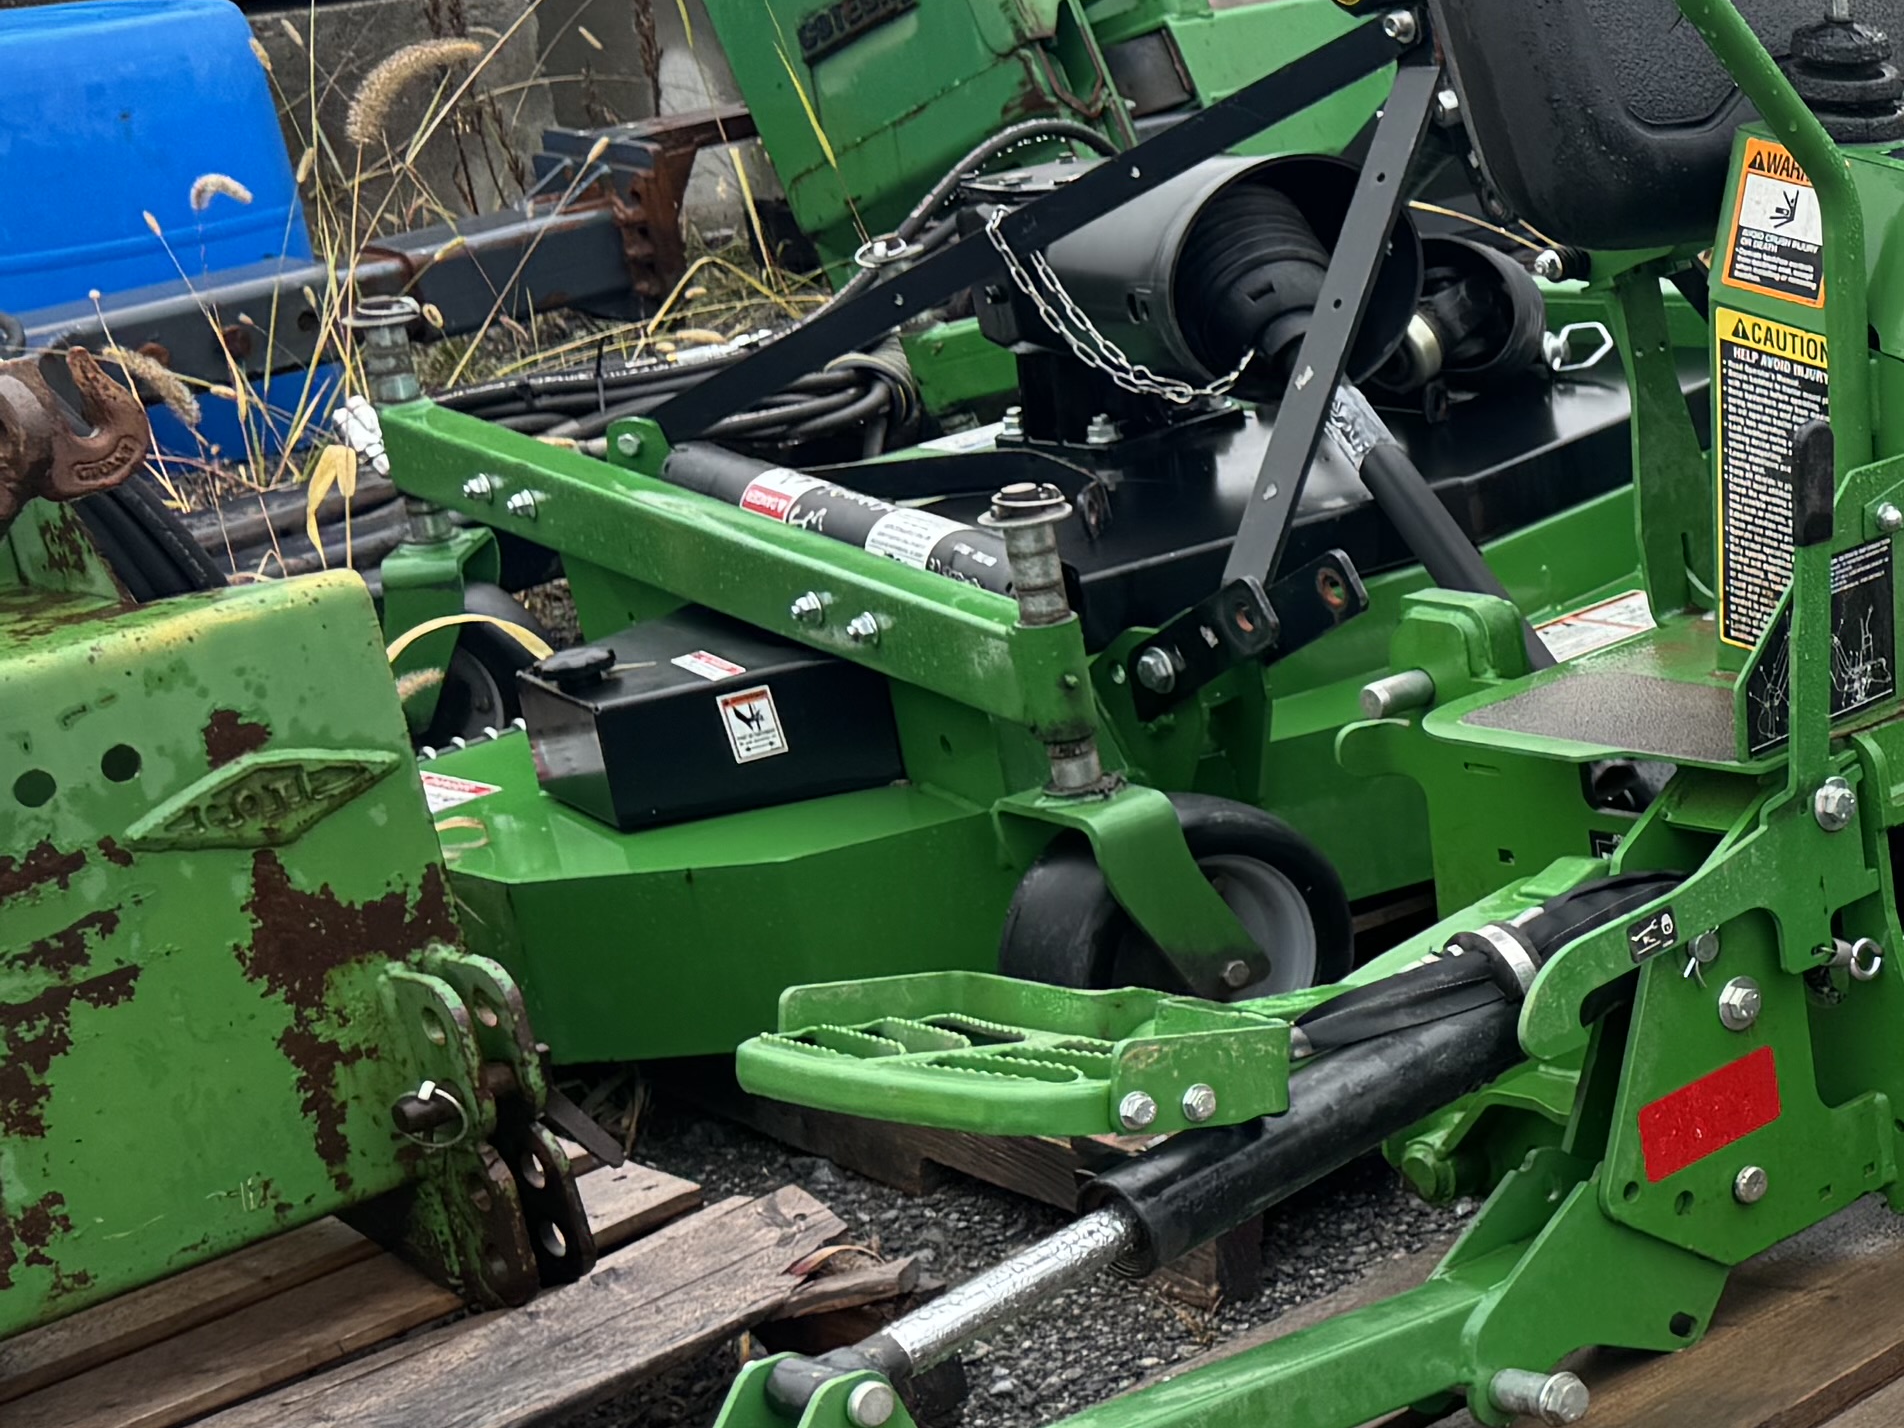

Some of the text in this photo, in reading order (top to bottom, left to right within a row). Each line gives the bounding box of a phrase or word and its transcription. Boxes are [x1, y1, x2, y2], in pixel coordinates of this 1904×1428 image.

[1752, 322, 1828, 363] CAUTION
[1733, 347, 1829, 385] HELP AVOID INJURY
